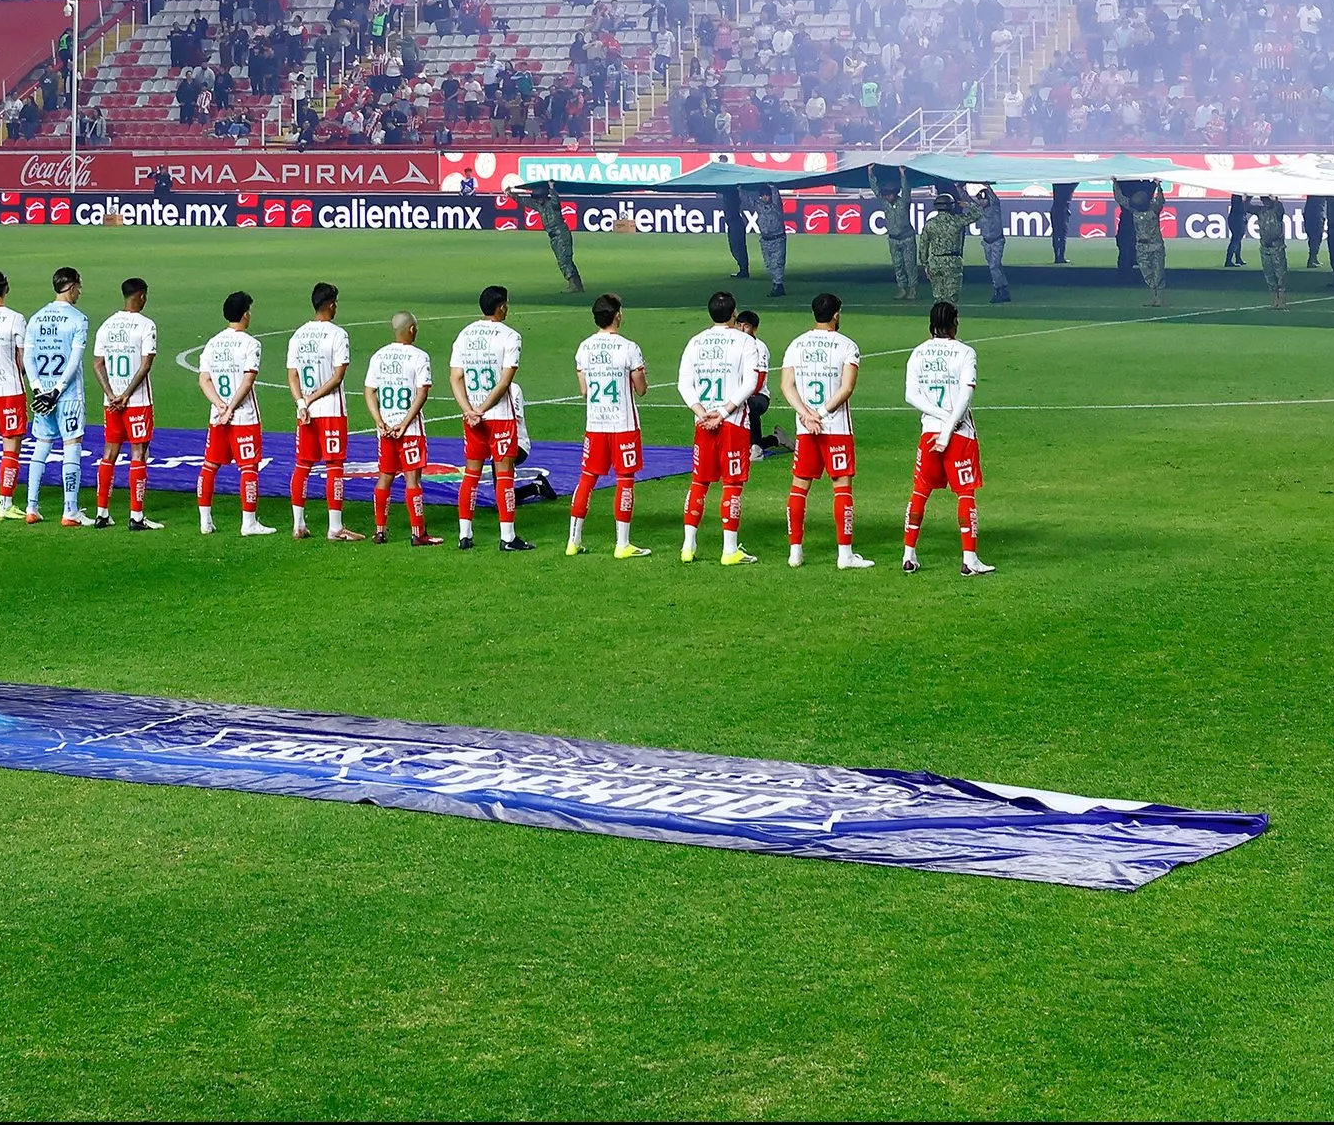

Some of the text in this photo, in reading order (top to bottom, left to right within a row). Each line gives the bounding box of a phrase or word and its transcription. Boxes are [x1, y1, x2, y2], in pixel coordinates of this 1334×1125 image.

[134, 164, 238, 185] PRMA
[281, 164, 384, 185] PIRMA
[526, 163, 672, 182] ENTRA A GANAR
[318, 198, 483, 229] caliente.mx
[40, 324, 58, 336] bait
[108, 330, 130, 343] bait
[468, 337, 488, 350] bait
[698, 345, 724, 361] bait
[37, 354, 66, 376] 22
[108, 355, 131, 377] 10
[588, 351, 612, 365] bait
[803, 348, 829, 363] bait
[922, 356, 949, 373] bait
[302, 365, 315, 388] 6
[380, 361, 403, 375] bait
[218, 375, 232, 397] 8
[466, 368, 497, 392] 33
[699, 377, 724, 402] 21
[589, 379, 620, 404] 24
[807, 380, 824, 406] 3
[929, 385, 946, 408] 7
[829, 445, 846, 453] Mobil
[954, 458, 972, 468] Mobil
